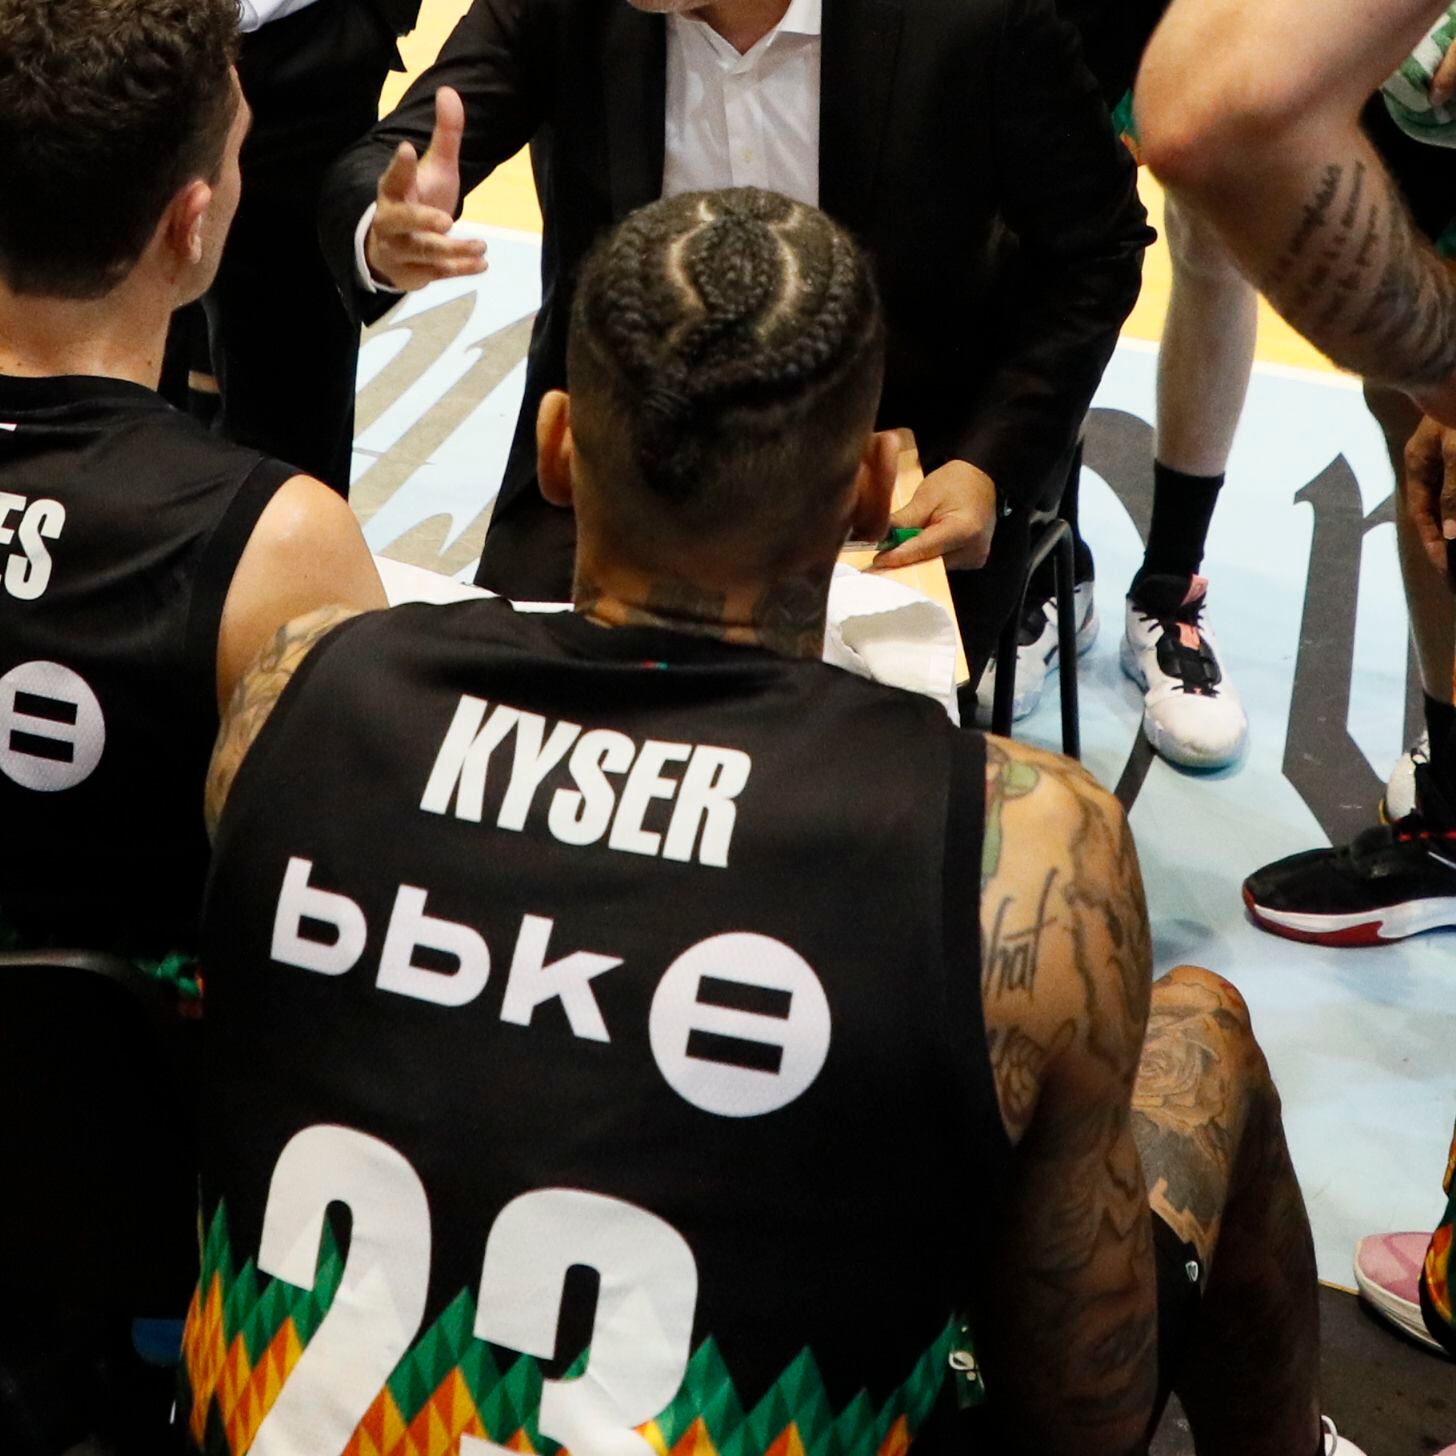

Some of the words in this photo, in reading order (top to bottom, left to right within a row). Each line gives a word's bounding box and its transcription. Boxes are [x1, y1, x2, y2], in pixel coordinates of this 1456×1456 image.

[419, 693, 751, 869] KYSER
[268, 855, 626, 1045] bbk
[245, 1122, 700, 1456] 23
